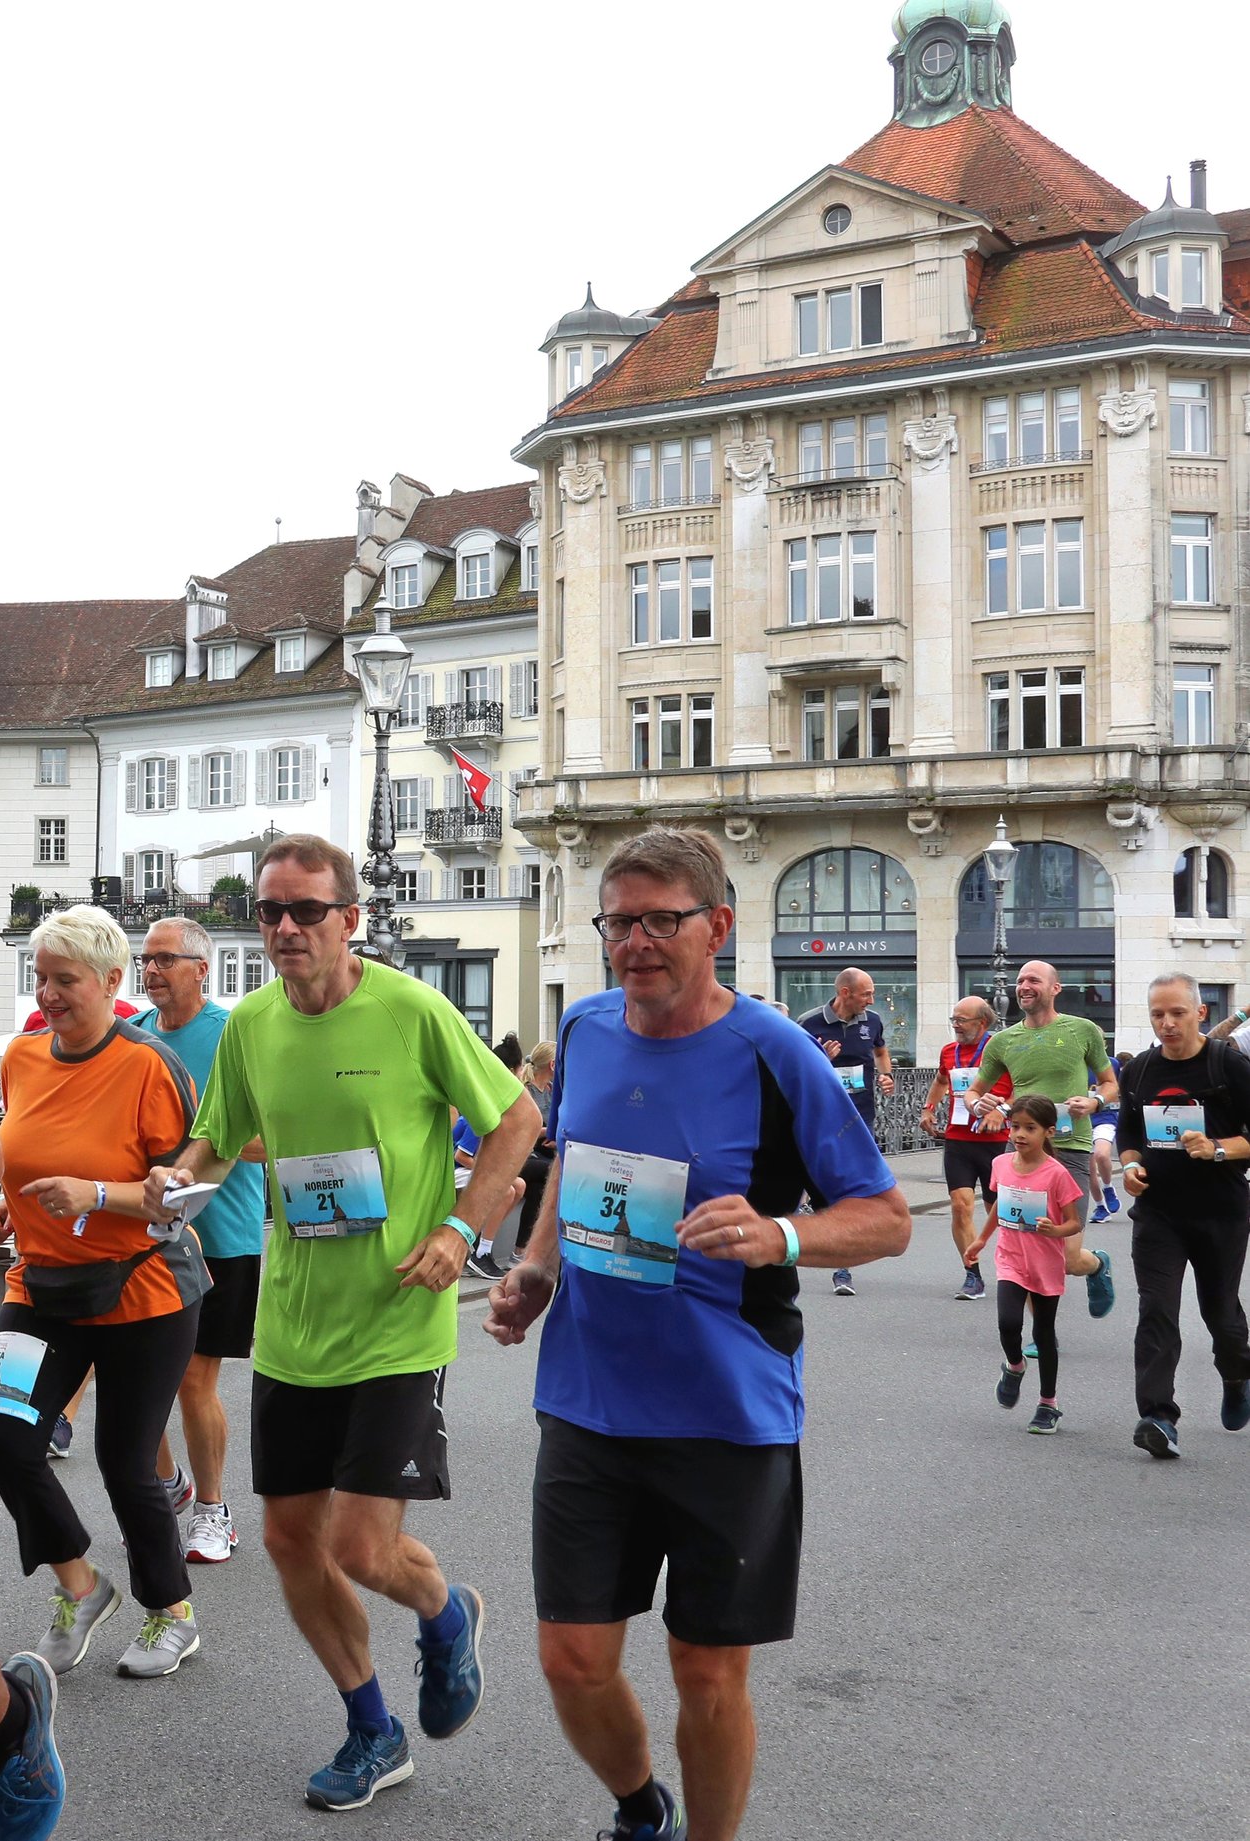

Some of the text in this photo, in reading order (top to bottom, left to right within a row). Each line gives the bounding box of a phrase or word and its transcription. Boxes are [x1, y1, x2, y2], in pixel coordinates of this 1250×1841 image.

[800, 939, 887, 954] COMPANYS
[1165, 1125, 1180, 1136] 58
[304, 1178, 345, 1192] NORBERT
[604, 1180, 629, 1197] UWE
[316, 1192, 336, 1211] 21
[599, 1196, 628, 1219] 34
[1010, 1207, 1023, 1218] 87
[588, 1235, 612, 1246] MIGROS
